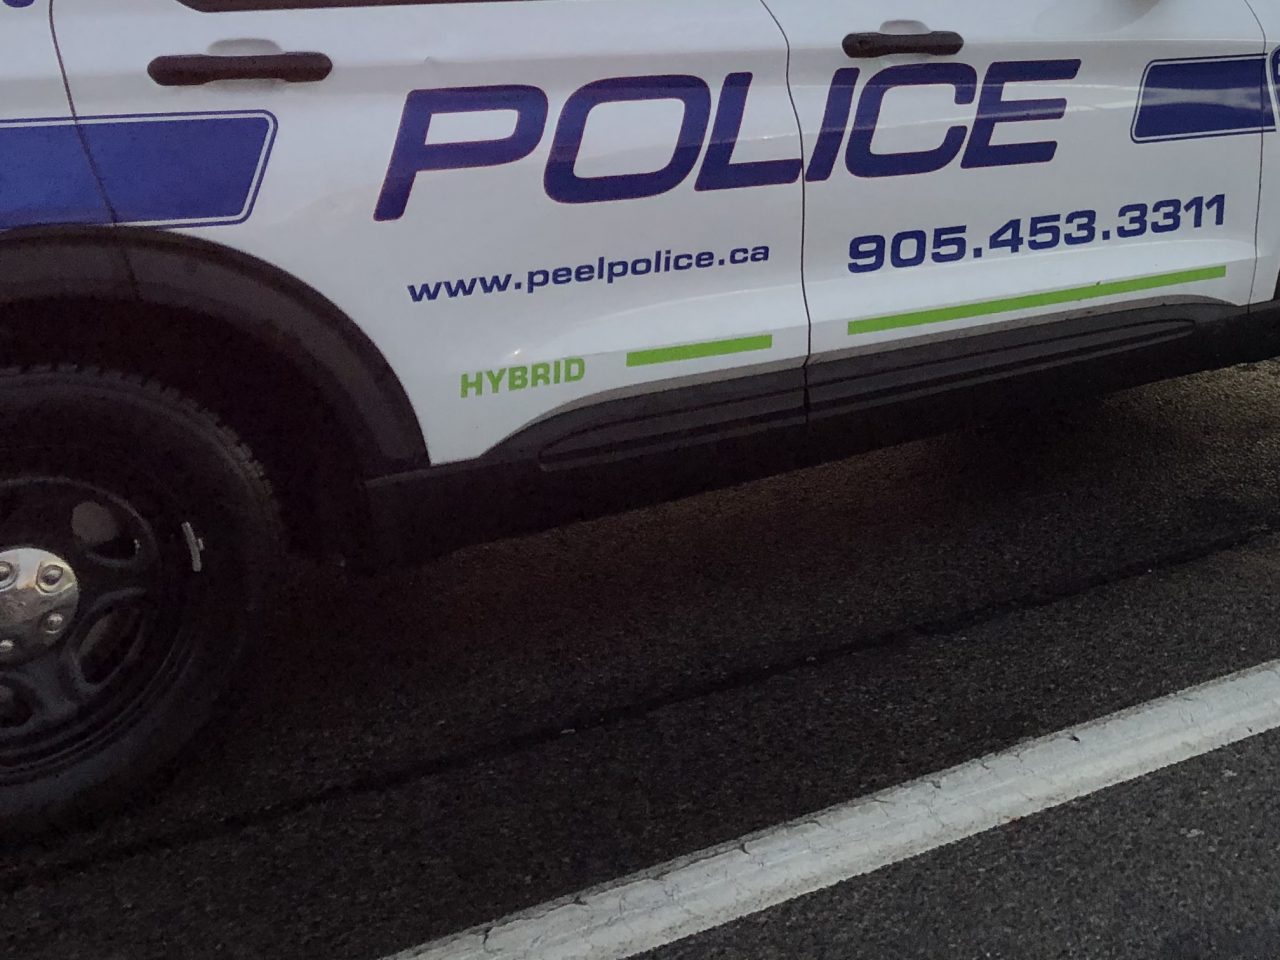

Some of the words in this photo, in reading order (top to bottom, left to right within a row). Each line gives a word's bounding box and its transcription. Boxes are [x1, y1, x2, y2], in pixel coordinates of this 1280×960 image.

[373, 58, 1082, 222] POLICE
[847, 193, 1226, 274] 905.453.3311
[407, 244, 770, 302] www.peelpolice.ca
[460, 357, 586, 398] HYBRID
